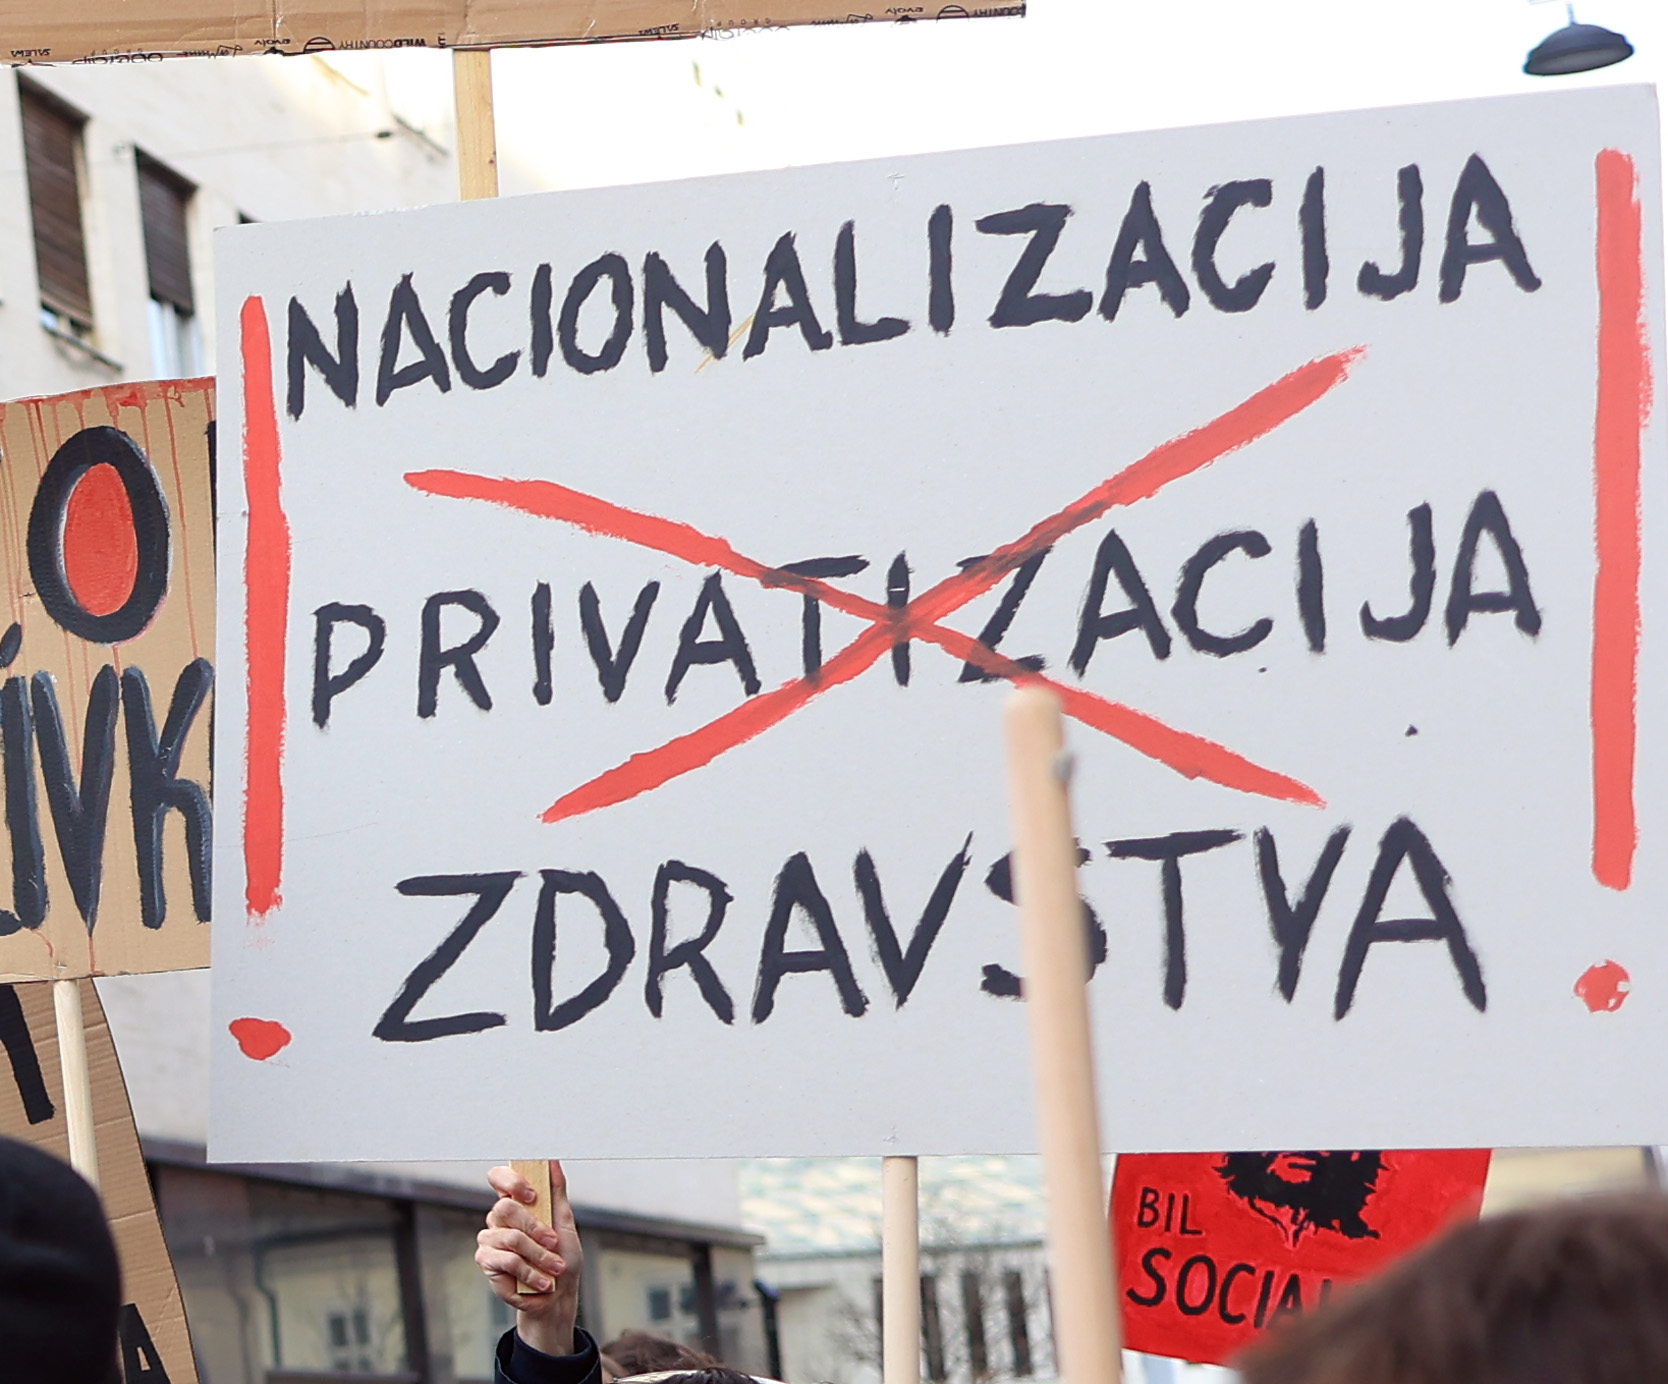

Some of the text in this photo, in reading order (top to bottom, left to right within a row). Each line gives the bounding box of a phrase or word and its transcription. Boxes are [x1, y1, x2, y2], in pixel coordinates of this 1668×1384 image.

[285, 152, 1542, 420] NACIONALIZACIJA
[311, 488, 1542, 729] PRIVATIZACIJA
[1136, 1185, 1203, 1237] BIL
